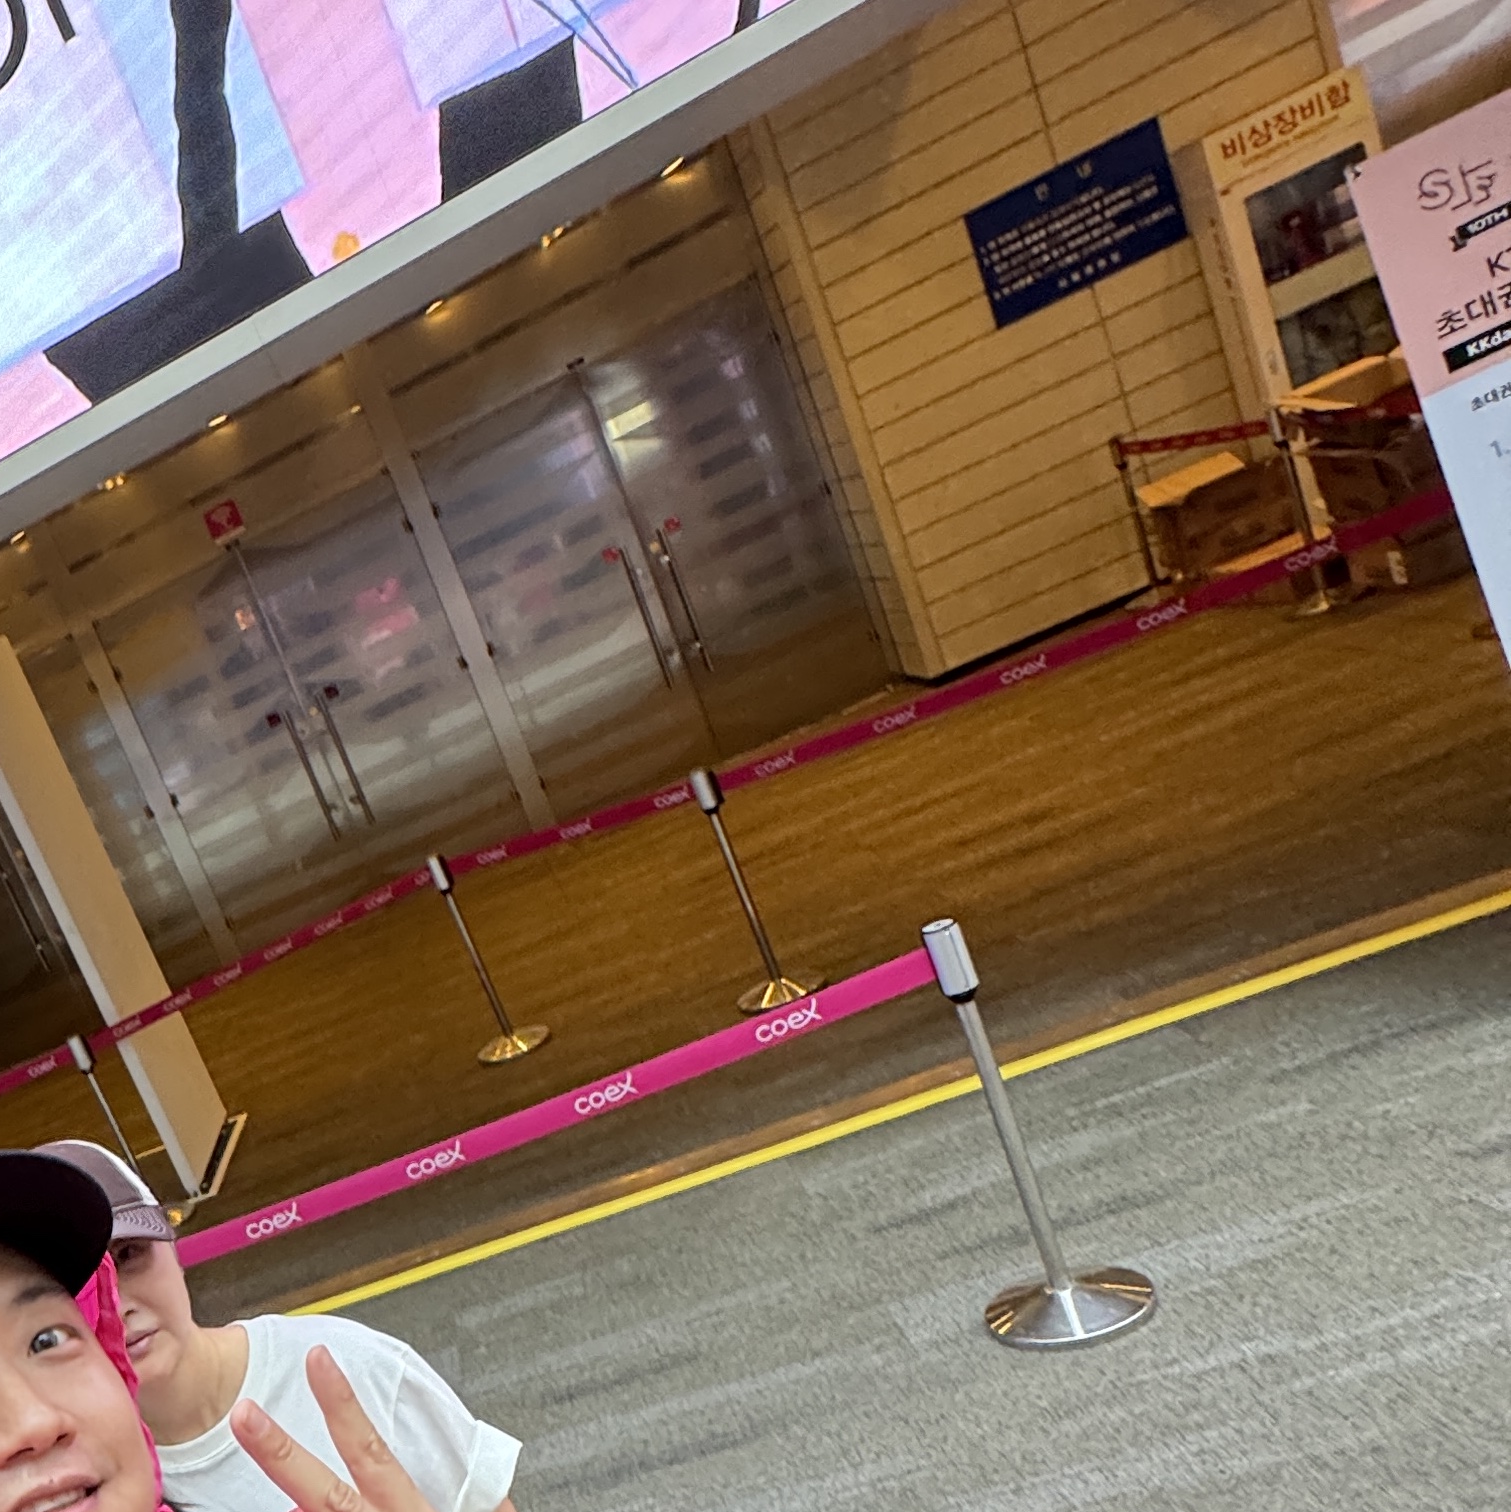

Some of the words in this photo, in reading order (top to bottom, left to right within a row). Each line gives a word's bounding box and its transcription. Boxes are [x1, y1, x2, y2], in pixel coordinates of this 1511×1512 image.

[1220, 79, 1351, 160] 비상장비함
[1136, 599, 1188, 632] coex
[999, 654, 1046, 685] coex
[872, 705, 917, 734] coex
[754, 999, 822, 1044] coex
[574, 1072, 638, 1115] coex
[406, 1140, 464, 1180] coex
[245, 1202, 302, 1240] coex
